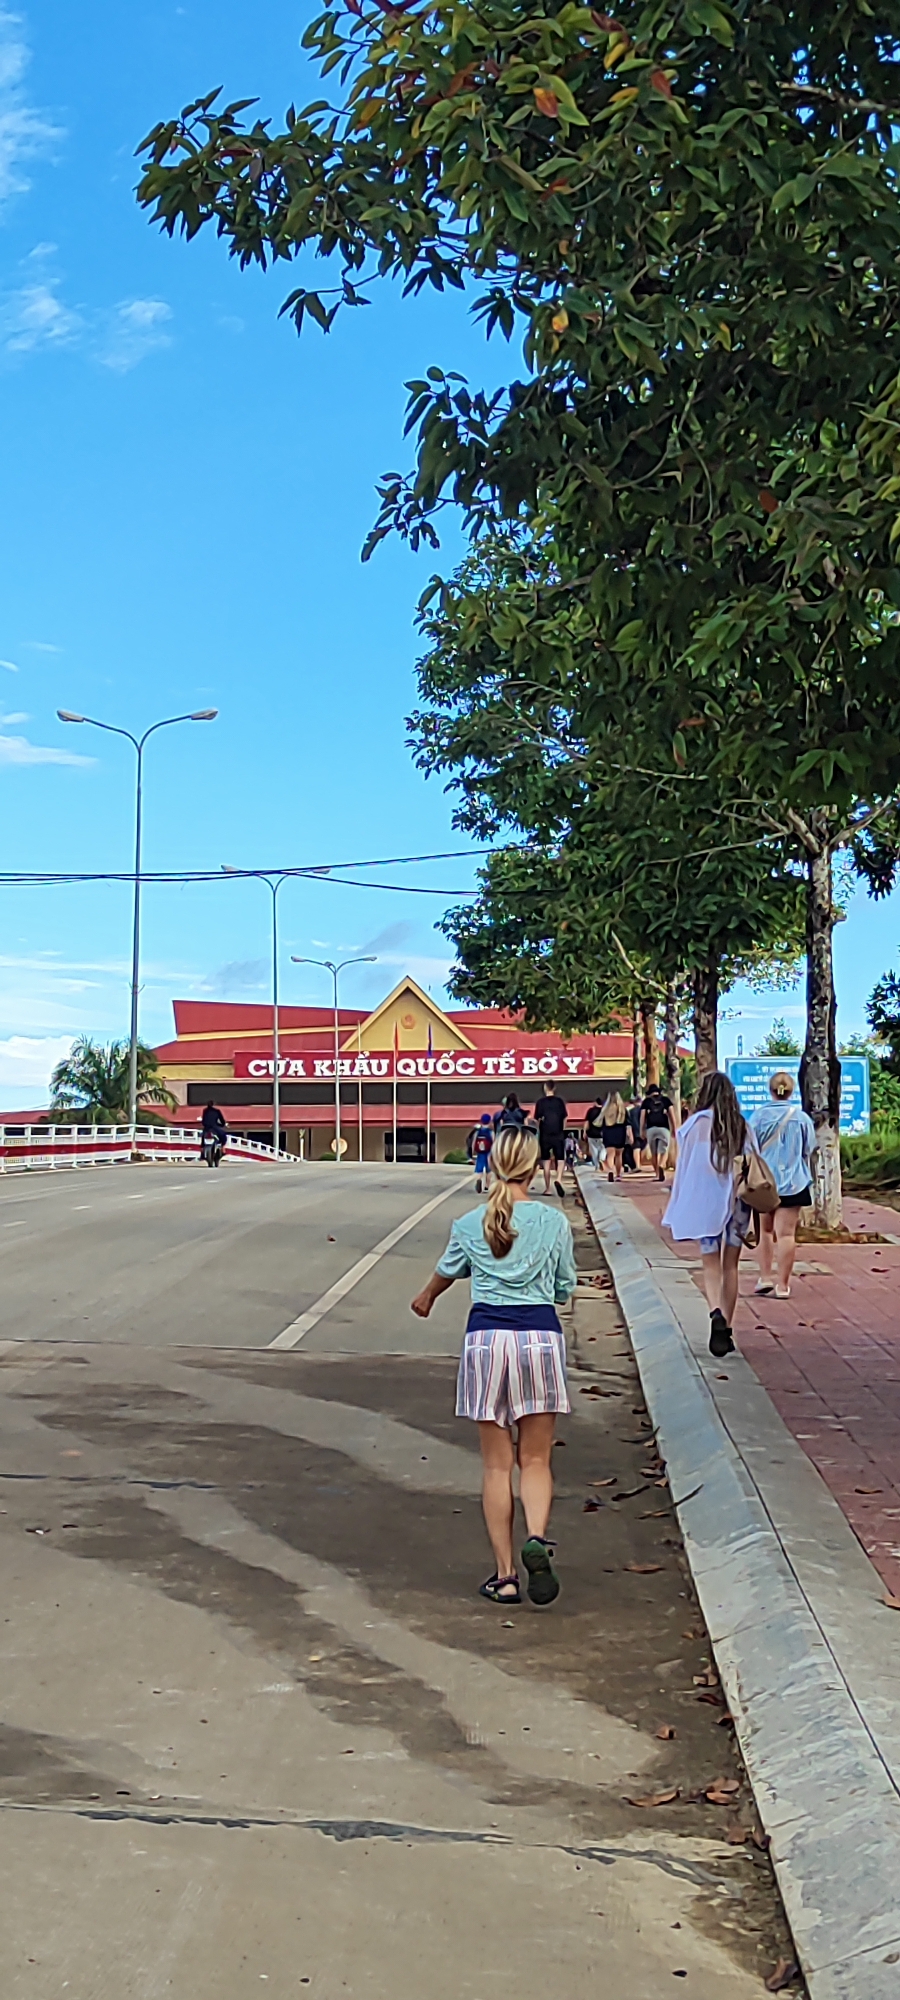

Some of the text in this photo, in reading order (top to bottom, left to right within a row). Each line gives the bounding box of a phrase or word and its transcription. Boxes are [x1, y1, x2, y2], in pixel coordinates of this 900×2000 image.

[247, 1049, 582, 1076] CỬA KHẨU QUỐC TẾ BỜ Y
